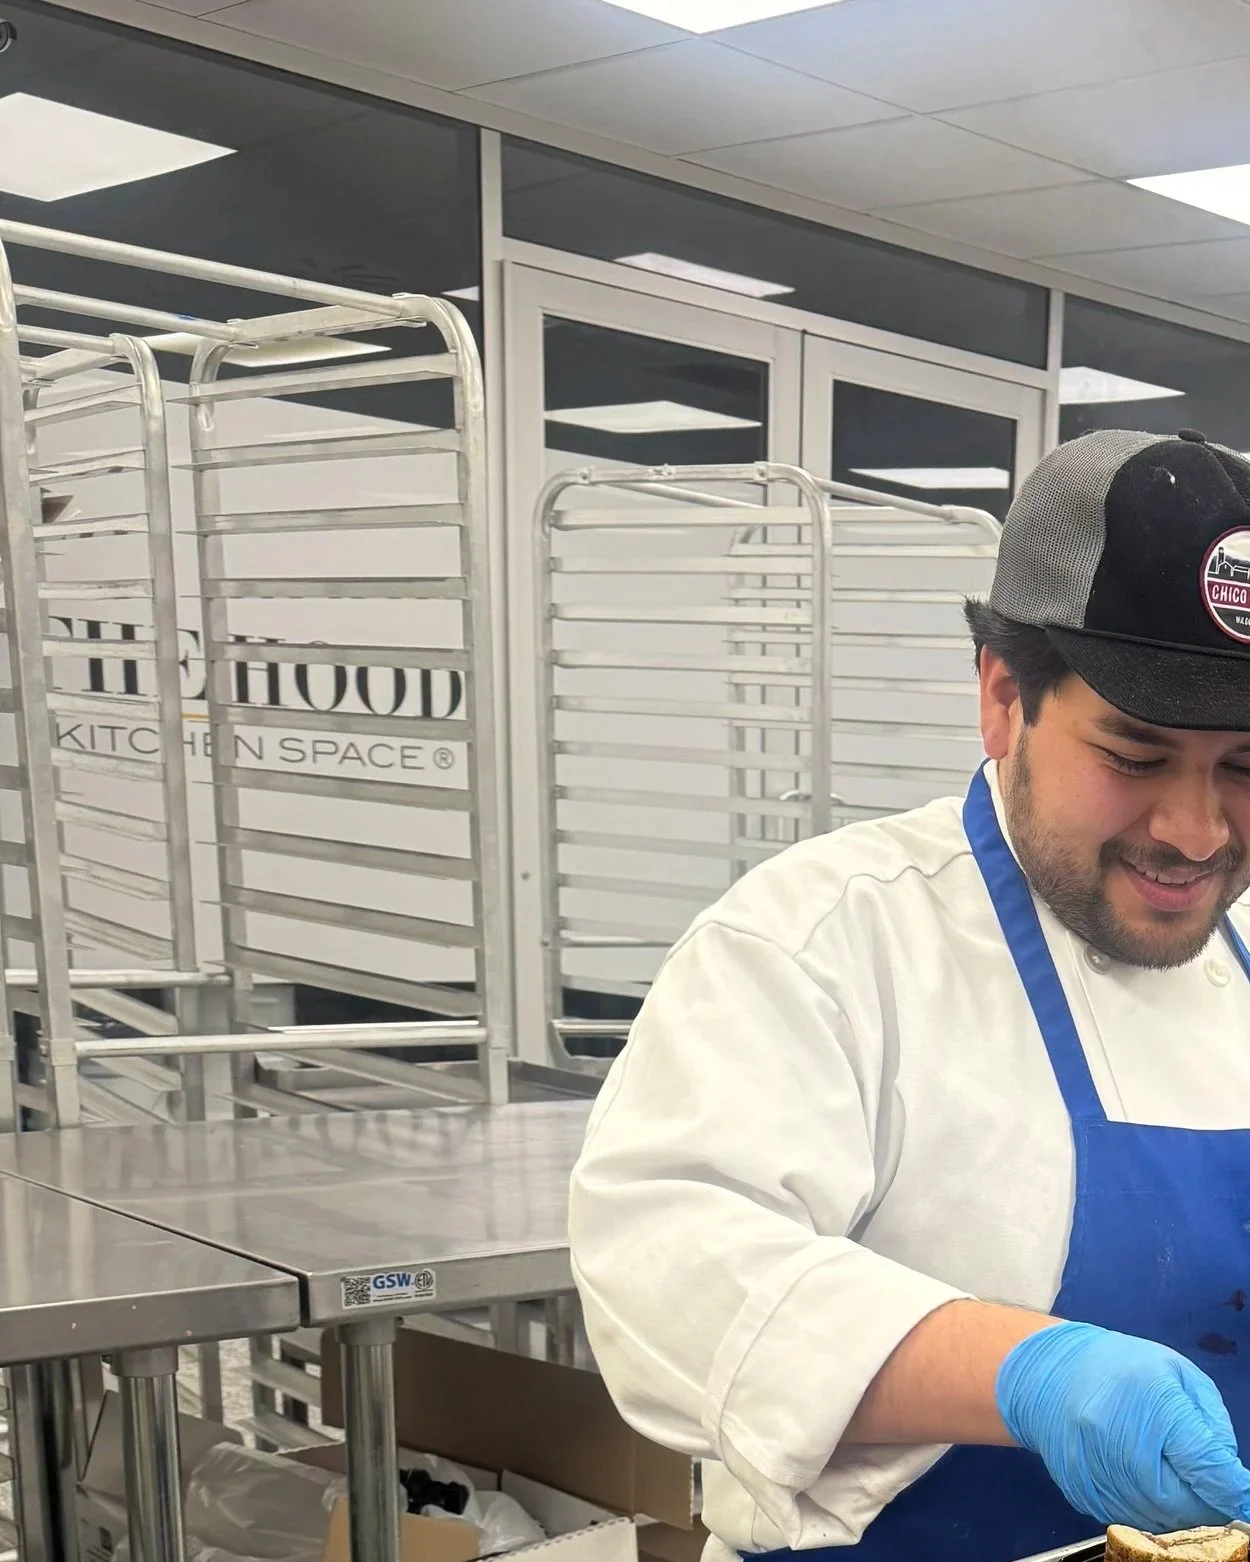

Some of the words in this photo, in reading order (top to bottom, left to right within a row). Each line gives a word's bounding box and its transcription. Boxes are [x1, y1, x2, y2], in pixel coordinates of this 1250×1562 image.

[1211, 584, 1247, 604] CHICO
[229, 633, 463, 718] HOOD
[372, 1272, 412, 1290] GSW
